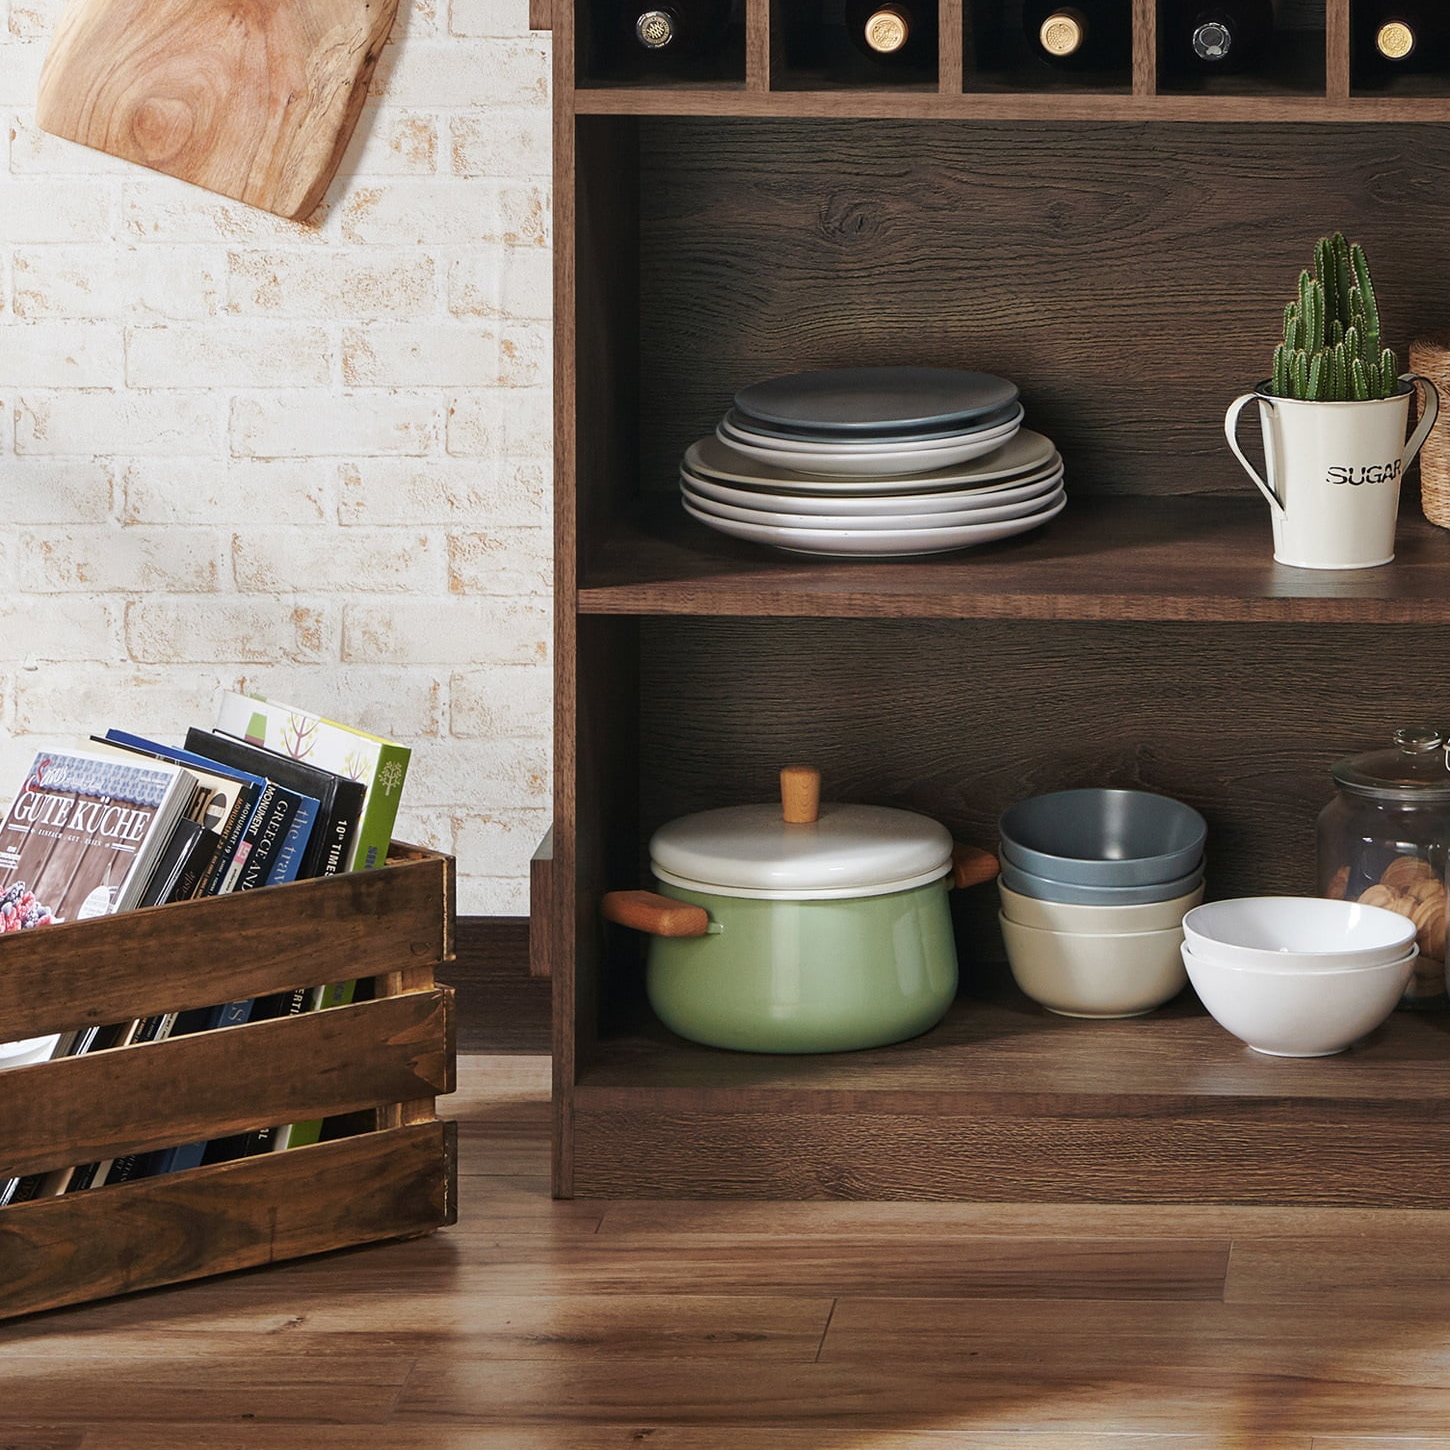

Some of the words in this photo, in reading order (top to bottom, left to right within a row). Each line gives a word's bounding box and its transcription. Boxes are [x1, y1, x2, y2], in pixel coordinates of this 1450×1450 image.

[1326, 458, 1403, 486] SUGAR
[14, 791, 76, 827] GUTE
[67, 796, 151, 841] KÜCHE
[223, 797, 244, 840] MONUMENT
[230, 802, 252, 845] MONUMENT
[248, 785, 276, 836] MONUMENT
[255, 800, 289, 860] GREECE
[289, 809, 308, 840] the
[241, 860, 261, 891] AND
[324, 844, 342, 877] TIMES
